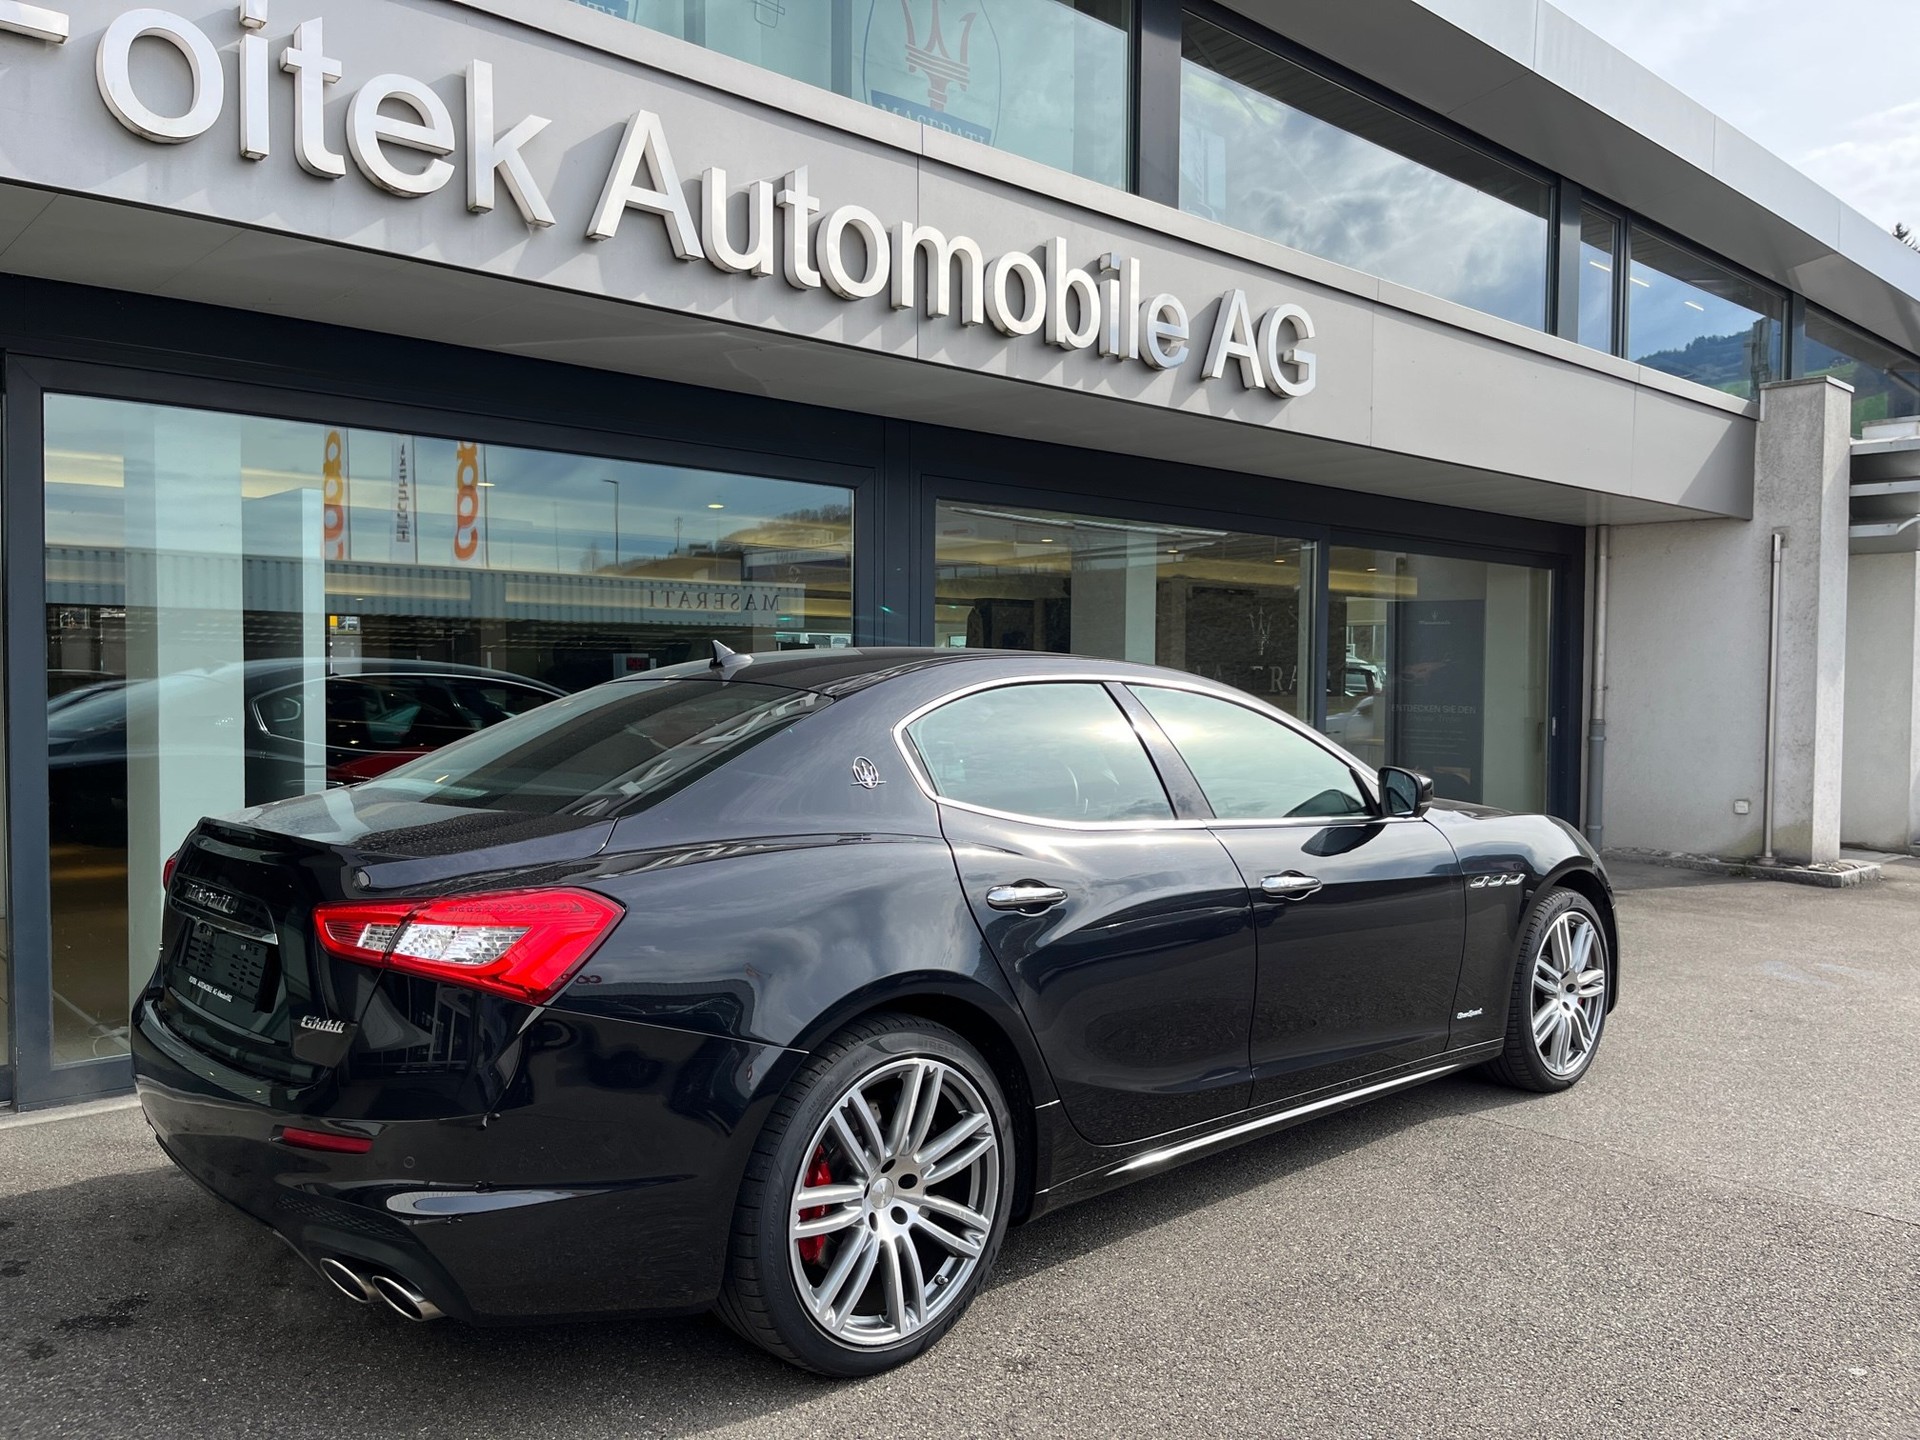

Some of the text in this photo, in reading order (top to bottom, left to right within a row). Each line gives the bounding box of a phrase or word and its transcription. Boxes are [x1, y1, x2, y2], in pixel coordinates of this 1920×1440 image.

[0, 0, 1317, 398] oitek Automobile AG
[300, 1014, 346, 1034] Ghibli
